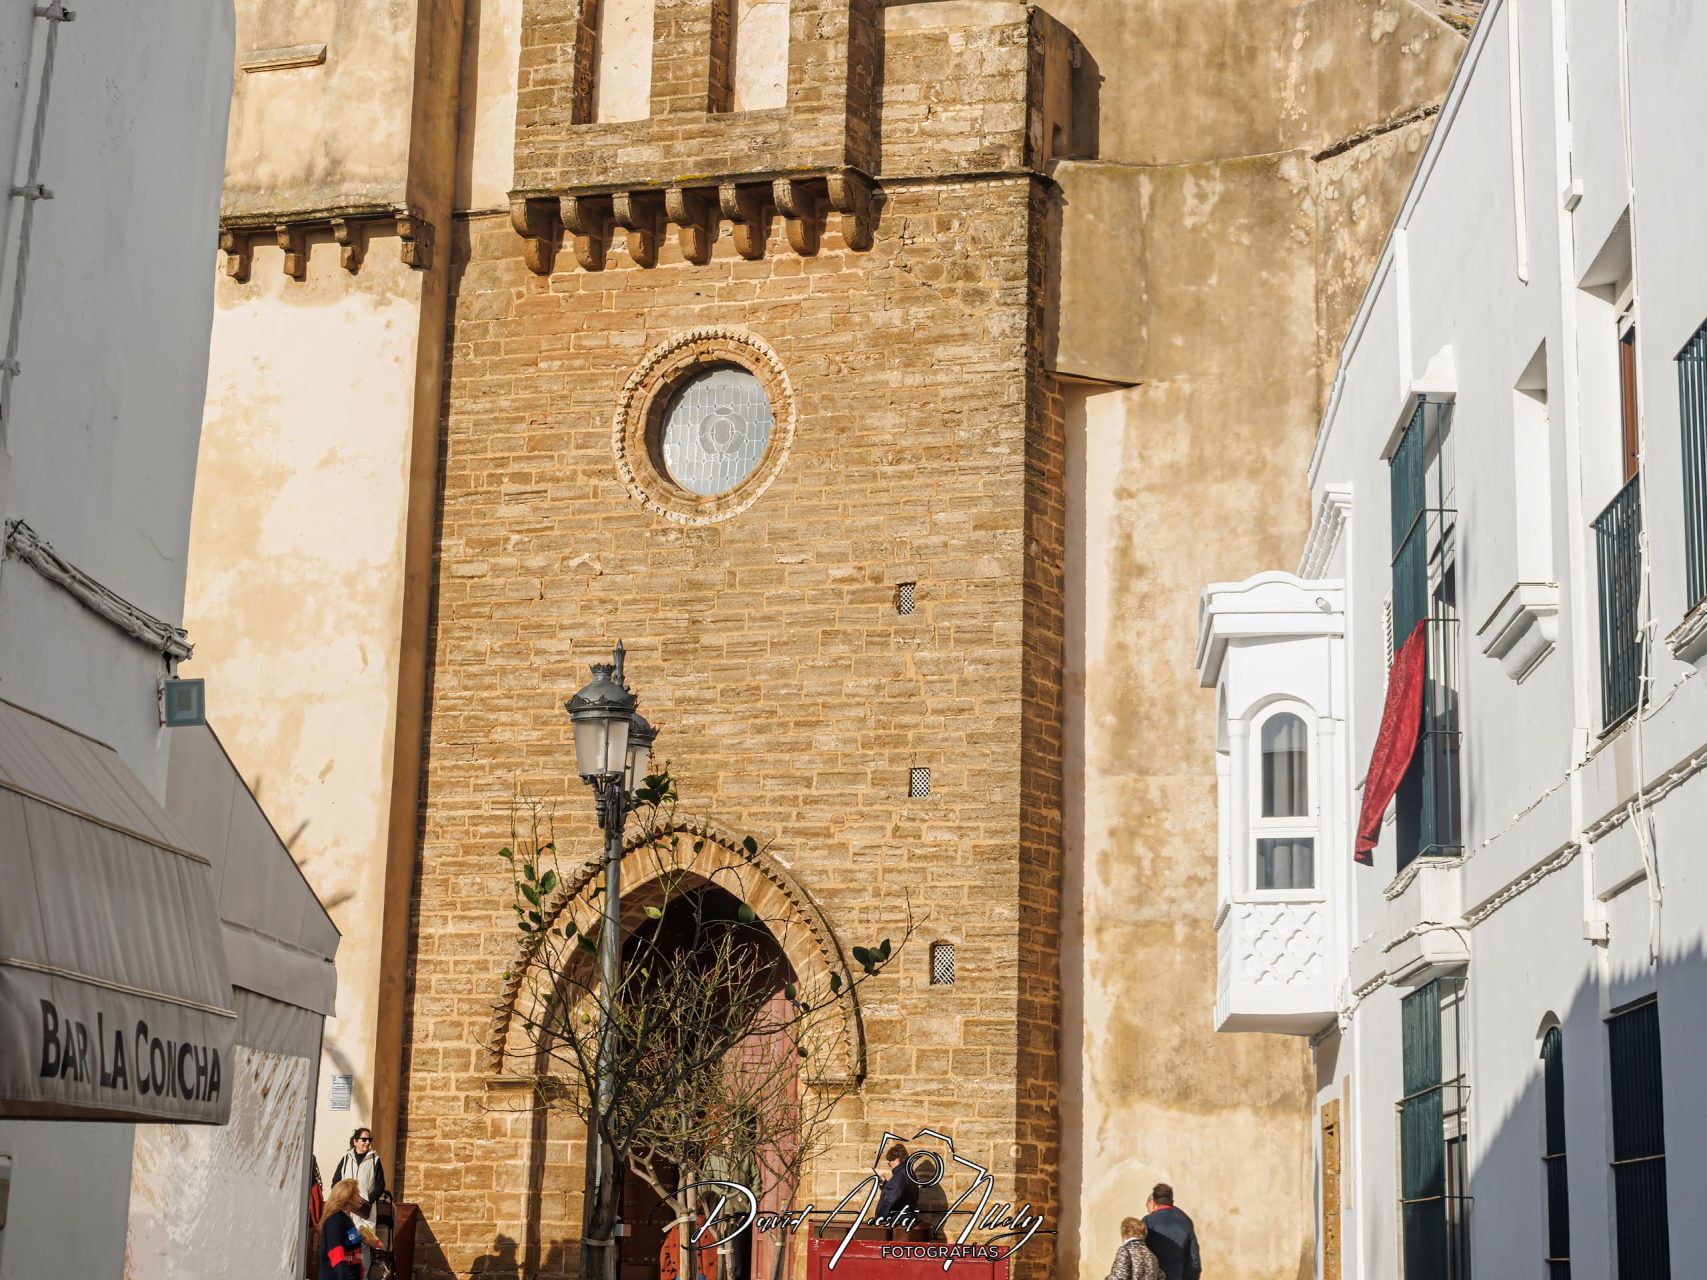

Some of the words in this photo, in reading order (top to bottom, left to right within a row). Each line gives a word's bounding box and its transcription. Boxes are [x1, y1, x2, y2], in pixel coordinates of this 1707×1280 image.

[40, 999, 91, 1084] BAR
[97, 1011, 128, 1091] LA
[135, 1019, 221, 1103] CONCHA
